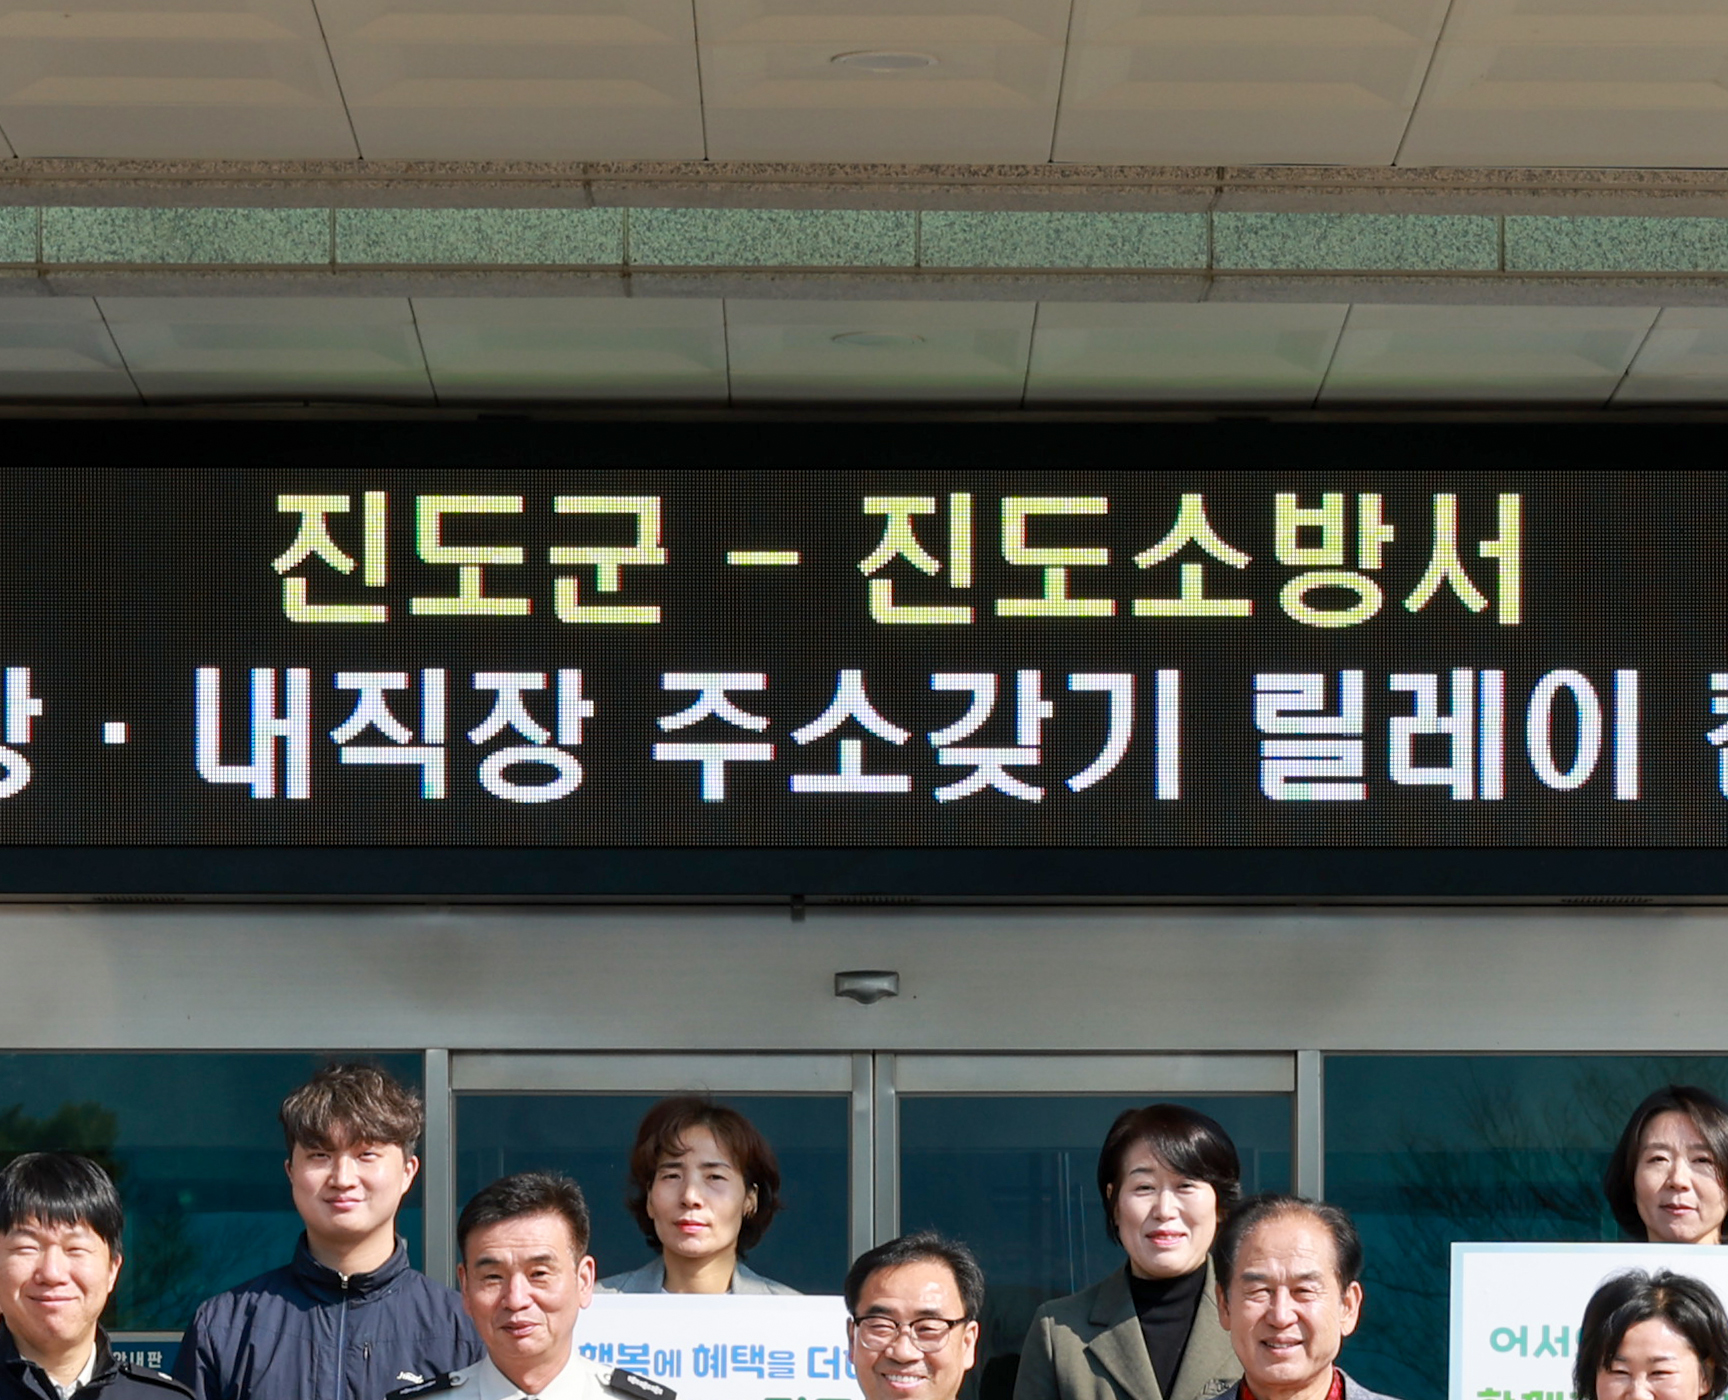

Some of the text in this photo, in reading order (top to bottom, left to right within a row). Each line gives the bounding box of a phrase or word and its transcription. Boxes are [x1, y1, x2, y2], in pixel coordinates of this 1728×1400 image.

[273, 489, 668, 625] 진도군
[860, 490, 1524, 628] 진도소방서
[194, 664, 596, 804] 내직장
[652, 668, 1181, 806] 주소갖기
[1254, 668, 1641, 803] 릴레이
[693, 1344, 796, 1379] 혜택을
